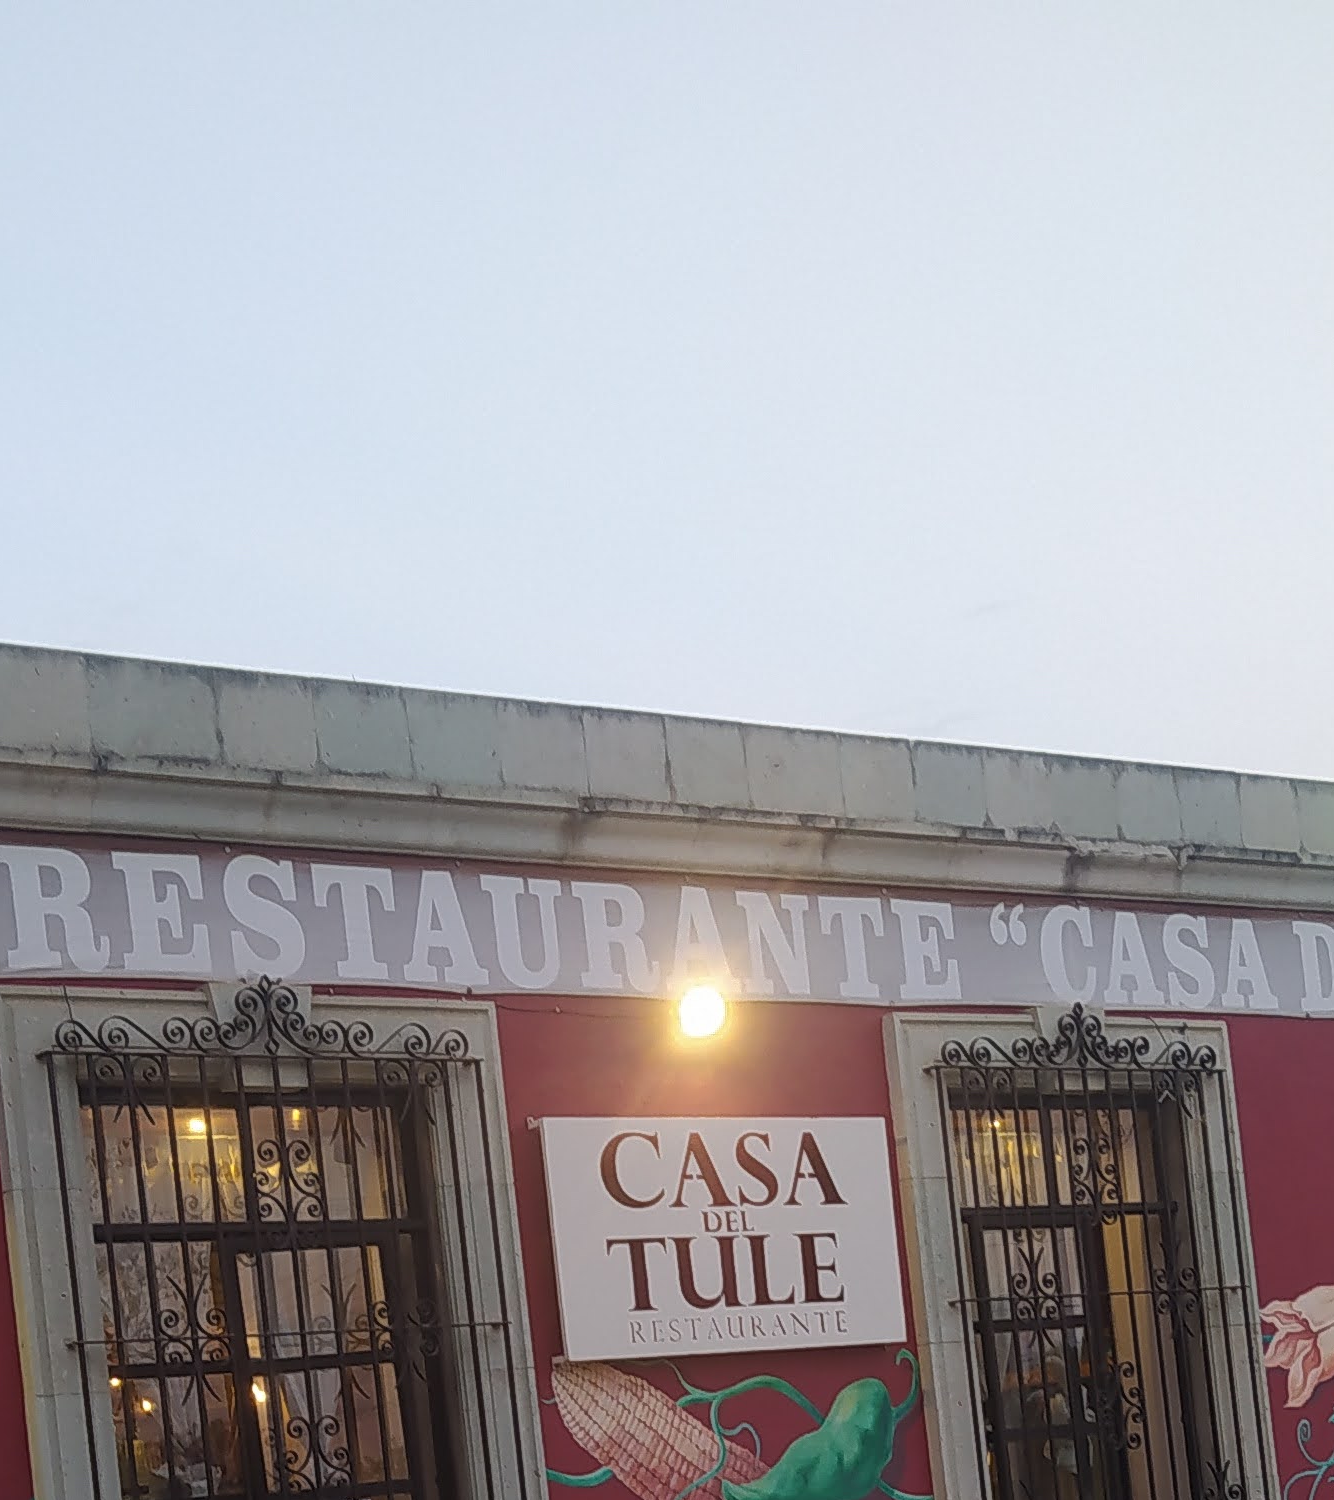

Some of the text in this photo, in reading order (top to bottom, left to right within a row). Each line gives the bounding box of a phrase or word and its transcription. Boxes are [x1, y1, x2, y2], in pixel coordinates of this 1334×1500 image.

[599, 1131, 849, 1208] CASA
[701, 1210, 755, 1233] DEL
[606, 1232, 845, 1312] TULE
[629, 1310, 848, 1343] RESTAURANTE
